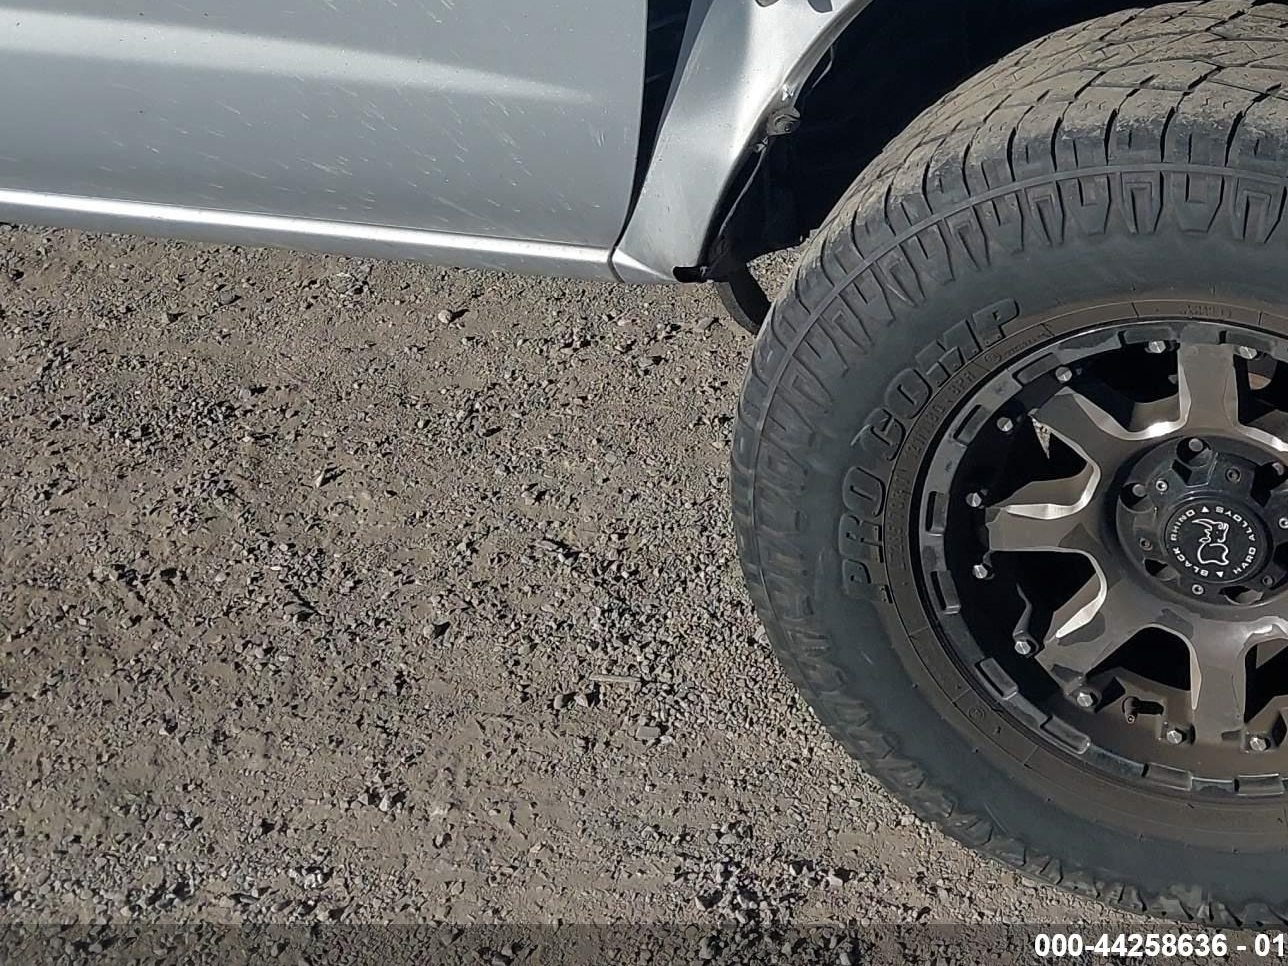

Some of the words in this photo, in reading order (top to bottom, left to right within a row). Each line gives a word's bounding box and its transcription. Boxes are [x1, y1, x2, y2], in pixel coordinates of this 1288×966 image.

[850, 298, 1021, 462] COMP
[837, 465, 893, 605] PRO
[1170, 509, 1196, 541] RHINO
[1215, 506, 1256, 541] ALLOYS
[1172, 546, 1209, 577] BLACK
[1232, 546, 1257, 575] HARD
